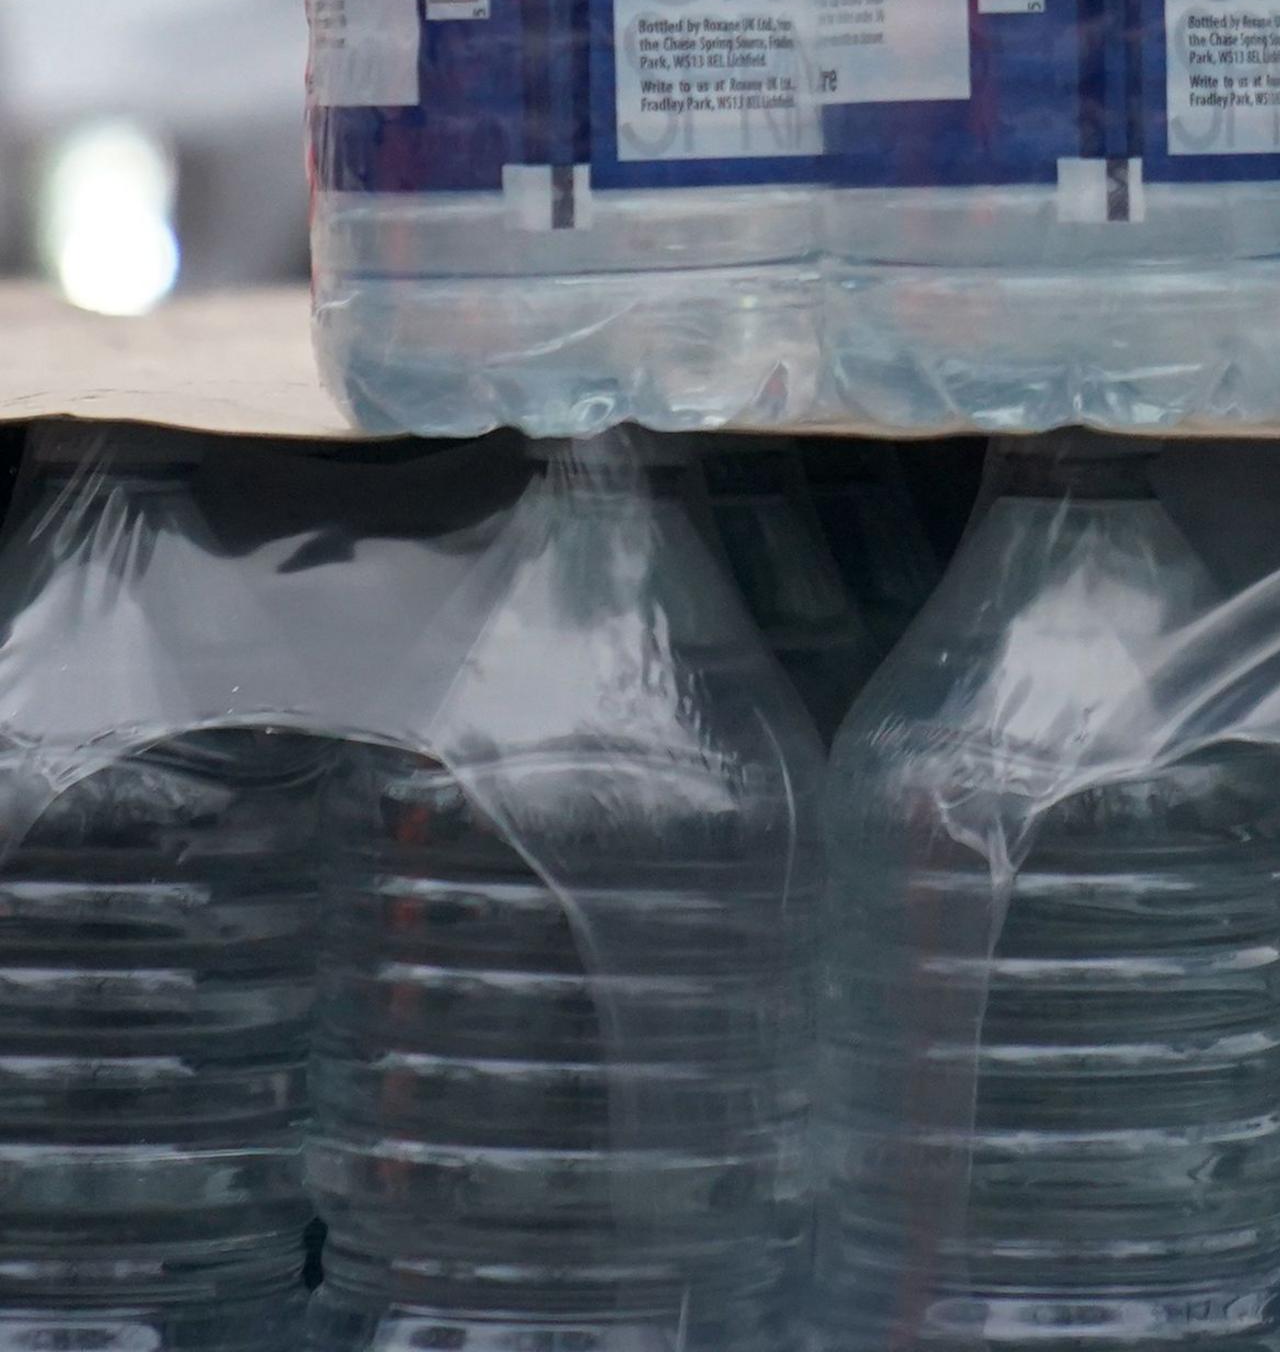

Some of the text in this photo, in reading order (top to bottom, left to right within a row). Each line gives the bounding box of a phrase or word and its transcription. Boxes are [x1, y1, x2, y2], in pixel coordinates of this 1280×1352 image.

[638, 19, 683, 33] Bottled
[687, 18, 699, 33] by
[703, 18, 740, 32] Roxane
[1188, 15, 1227, 29] Bottled
[1230, 15, 1240, 30] by
[639, 37, 659, 51] the
[663, 37, 696, 50] Chase
[699, 36, 732, 52] Spring
[1189, 34, 1206, 47] the
[1209, 32, 1238, 46] Chase
[640, 56, 670, 70] Park,
[672, 55, 704, 68] WS13
[1189, 51, 1216, 65] Park,
[1218, 50, 1245, 64] WS13
[641, 81, 673, 94] Write
[679, 81, 690, 93] to
[697, 82, 709, 92] us
[714, 80, 725, 91] at
[1190, 75, 1218, 88] Write
[1223, 75, 1233, 89] to
[1238, 76, 1248, 88] us
[1253, 74, 1262, 87] at
[641, 98, 687, 115] Fradley
[687, 97, 714, 112] Park,
[717, 97, 744, 110] WS13
[1189, 93, 1228, 109] Fradley
[1229, 93, 1253, 107] Park,
